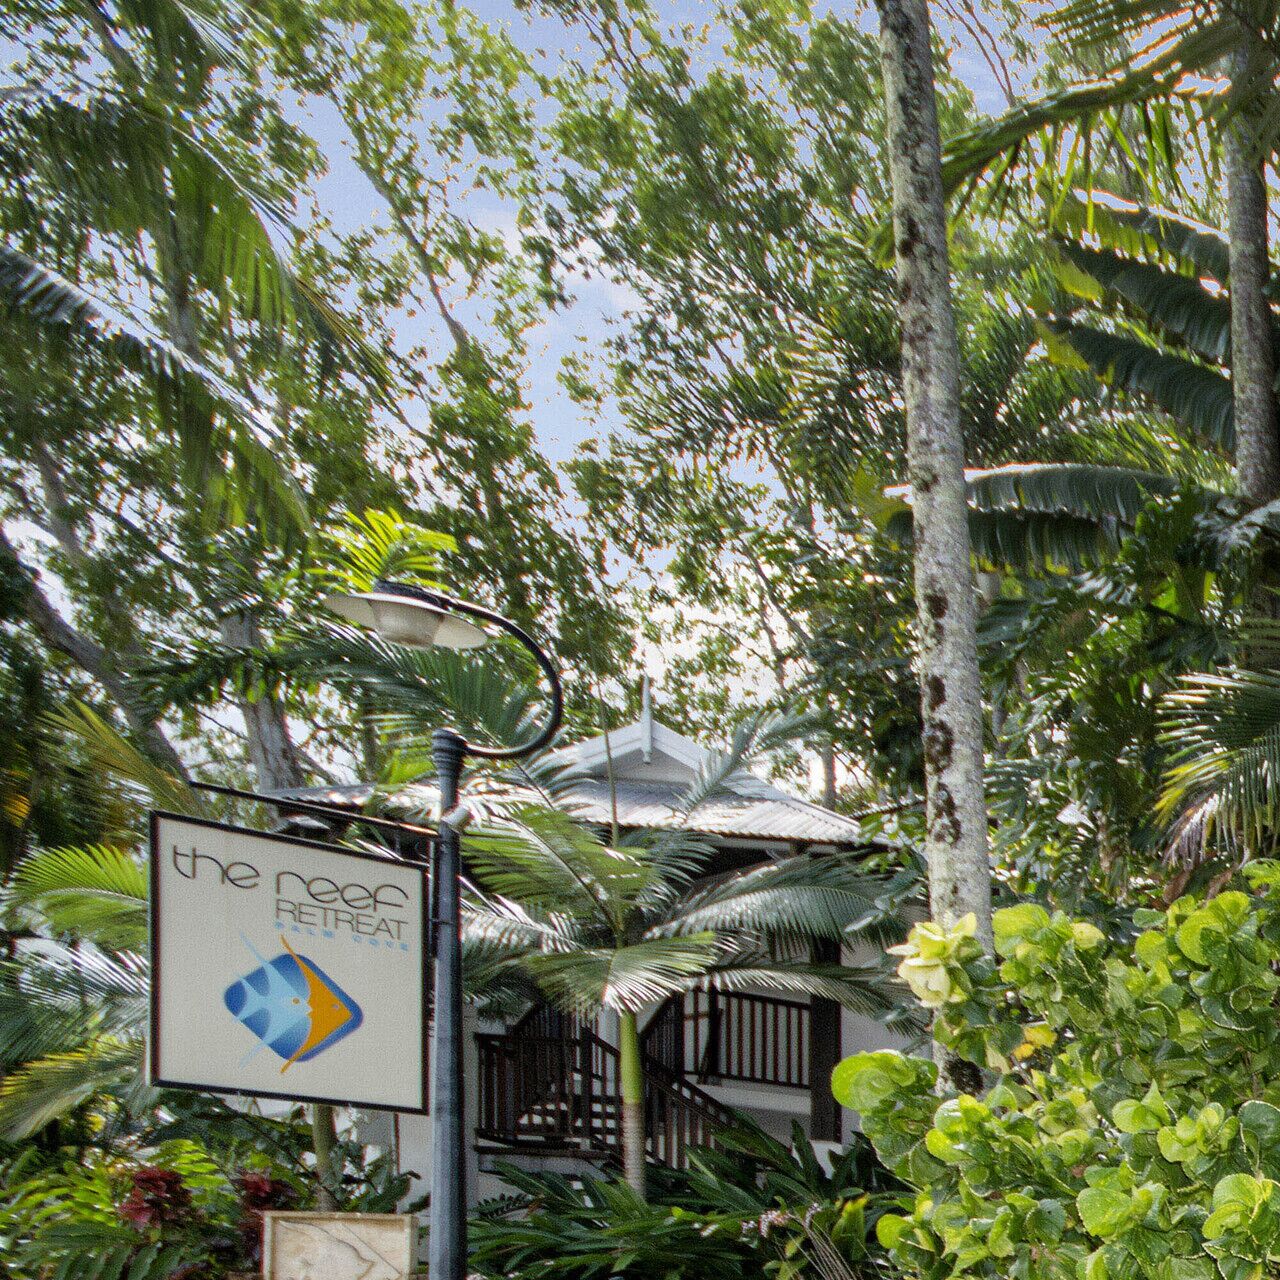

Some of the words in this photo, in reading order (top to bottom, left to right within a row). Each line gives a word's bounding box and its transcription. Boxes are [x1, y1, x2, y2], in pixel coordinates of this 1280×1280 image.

[172, 844, 260, 890] the
[275, 870, 410, 912] reef
[275, 898, 408, 940] RETREAT
